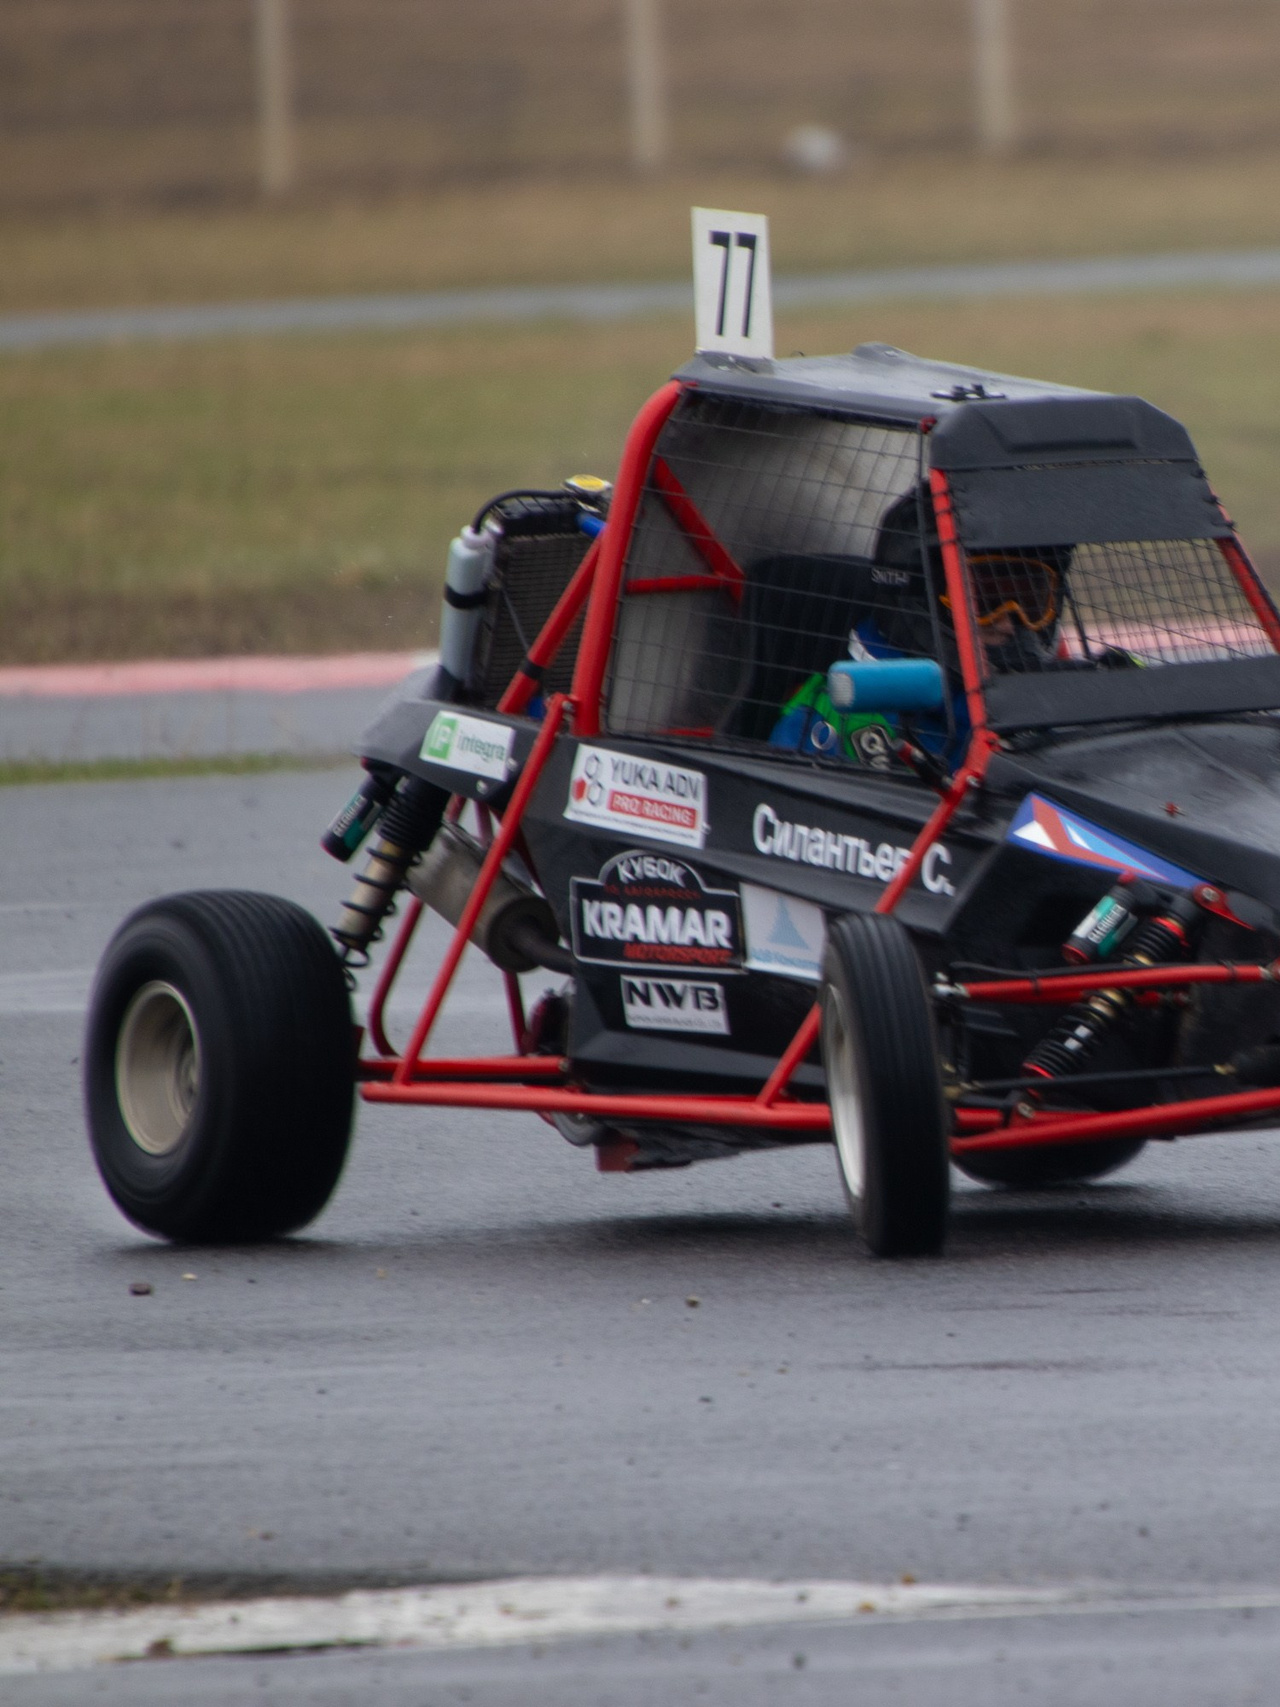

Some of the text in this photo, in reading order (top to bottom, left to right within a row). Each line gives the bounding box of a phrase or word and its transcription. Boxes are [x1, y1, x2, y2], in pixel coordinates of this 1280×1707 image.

[709, 230, 757, 338] 77
[457, 730, 506, 763] integra
[610, 757, 700, 800] YUKA ADV
[612, 793, 640, 815] PRO
[642, 798, 694, 826] RACING
[616, 856, 687, 888] КУБОК
[921, 843, 956, 897] С.
[582, 899, 732, 949] KRAMAR
[628, 980, 720, 1011] NWB
